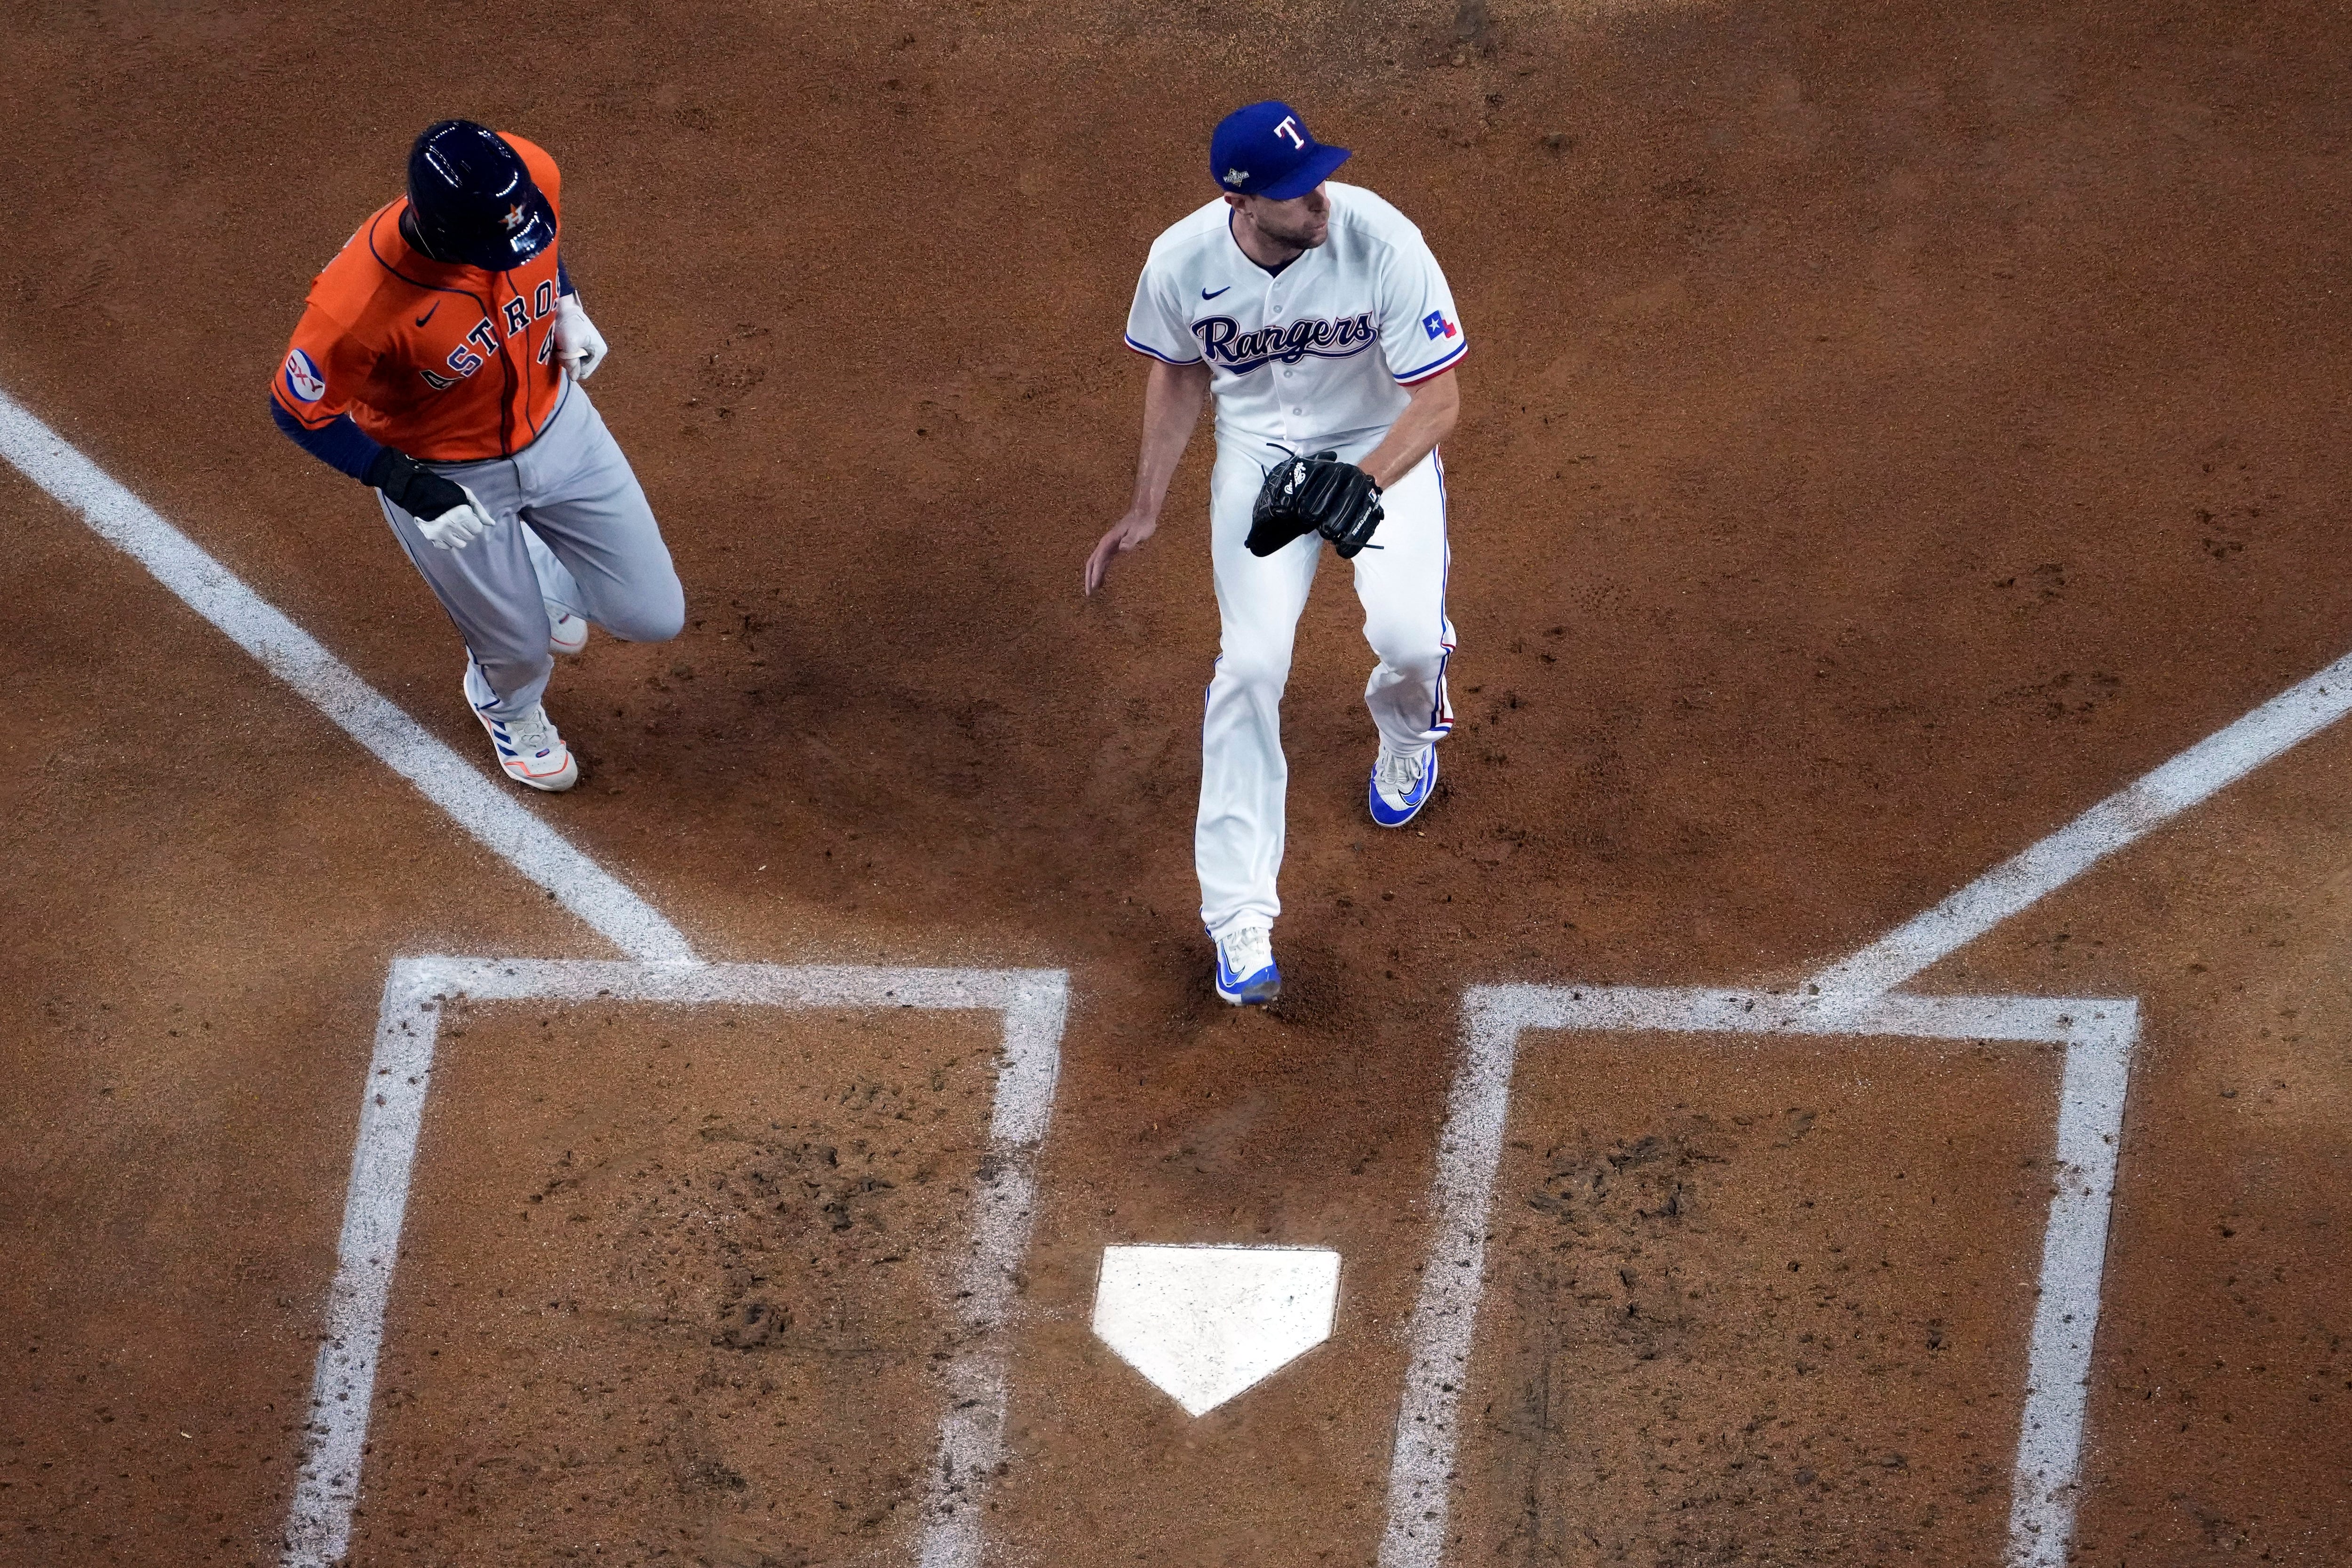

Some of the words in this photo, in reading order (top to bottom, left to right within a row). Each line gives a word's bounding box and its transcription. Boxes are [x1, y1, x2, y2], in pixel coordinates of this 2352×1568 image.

[1273, 115, 1305, 150] T
[505, 204, 524, 230] H
[1190, 312, 1378, 376] Rangers
[288, 355, 323, 392] OXY
